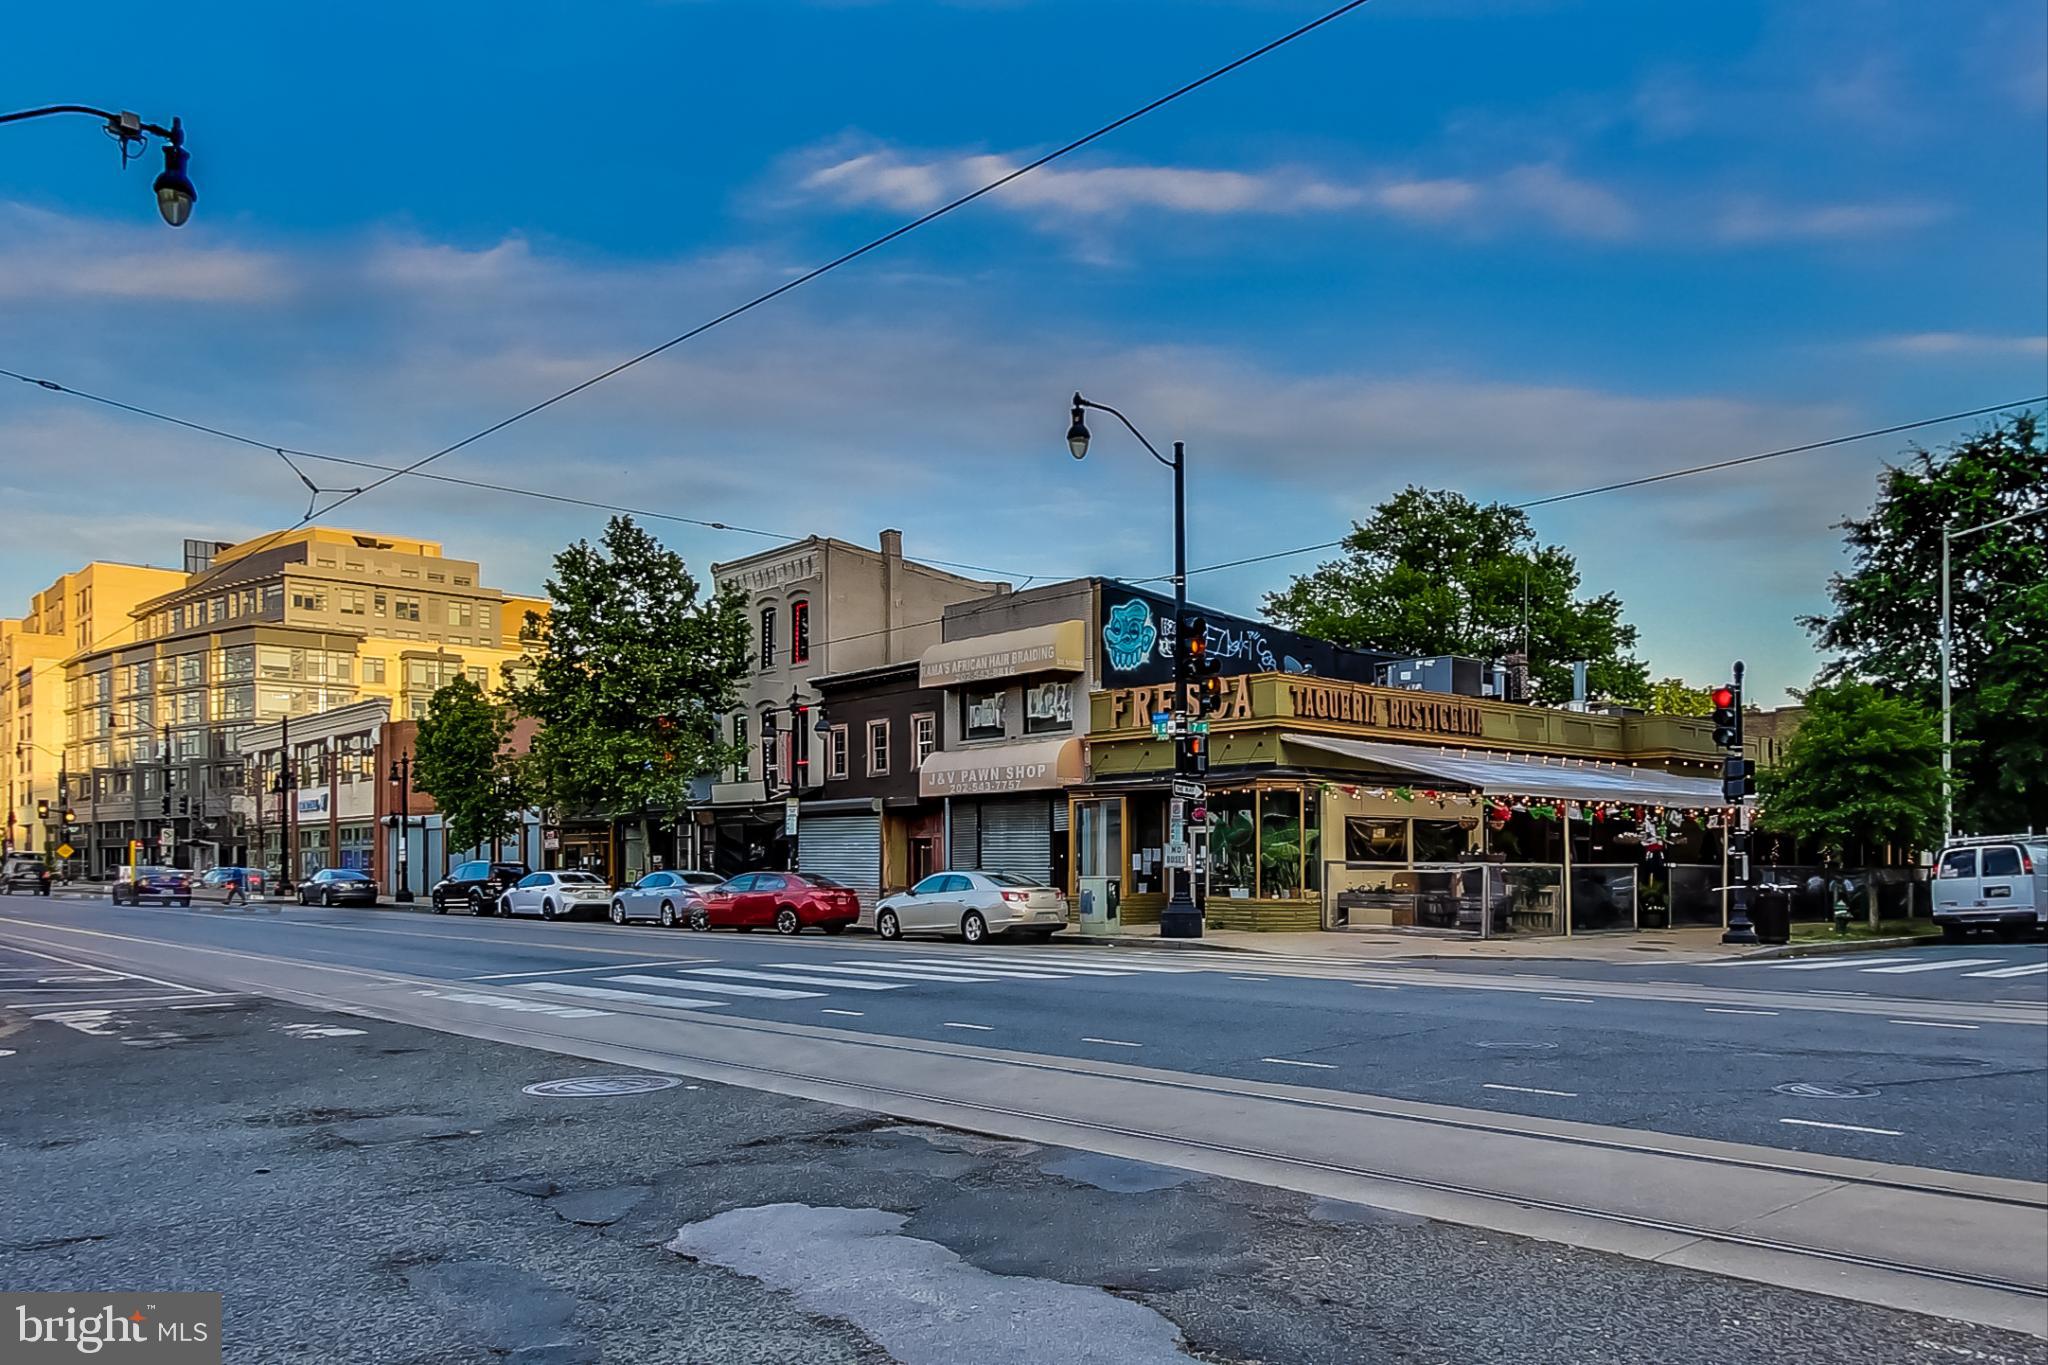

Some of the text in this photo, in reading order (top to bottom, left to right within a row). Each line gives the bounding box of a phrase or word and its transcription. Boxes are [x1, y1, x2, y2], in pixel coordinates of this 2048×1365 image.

[952, 658, 987, 674] AFRICAN
[988, 654, 1009, 669] HAIR
[1012, 647, 1055, 664] BRAIDING
[1290, 685, 1377, 723] TAQUERIA
[929, 772, 955, 785] J&V
[961, 767, 999, 783] PAWN
[1006, 764, 1046, 780] SHOP
[950, 780, 1021, 793] 202-543-7757
